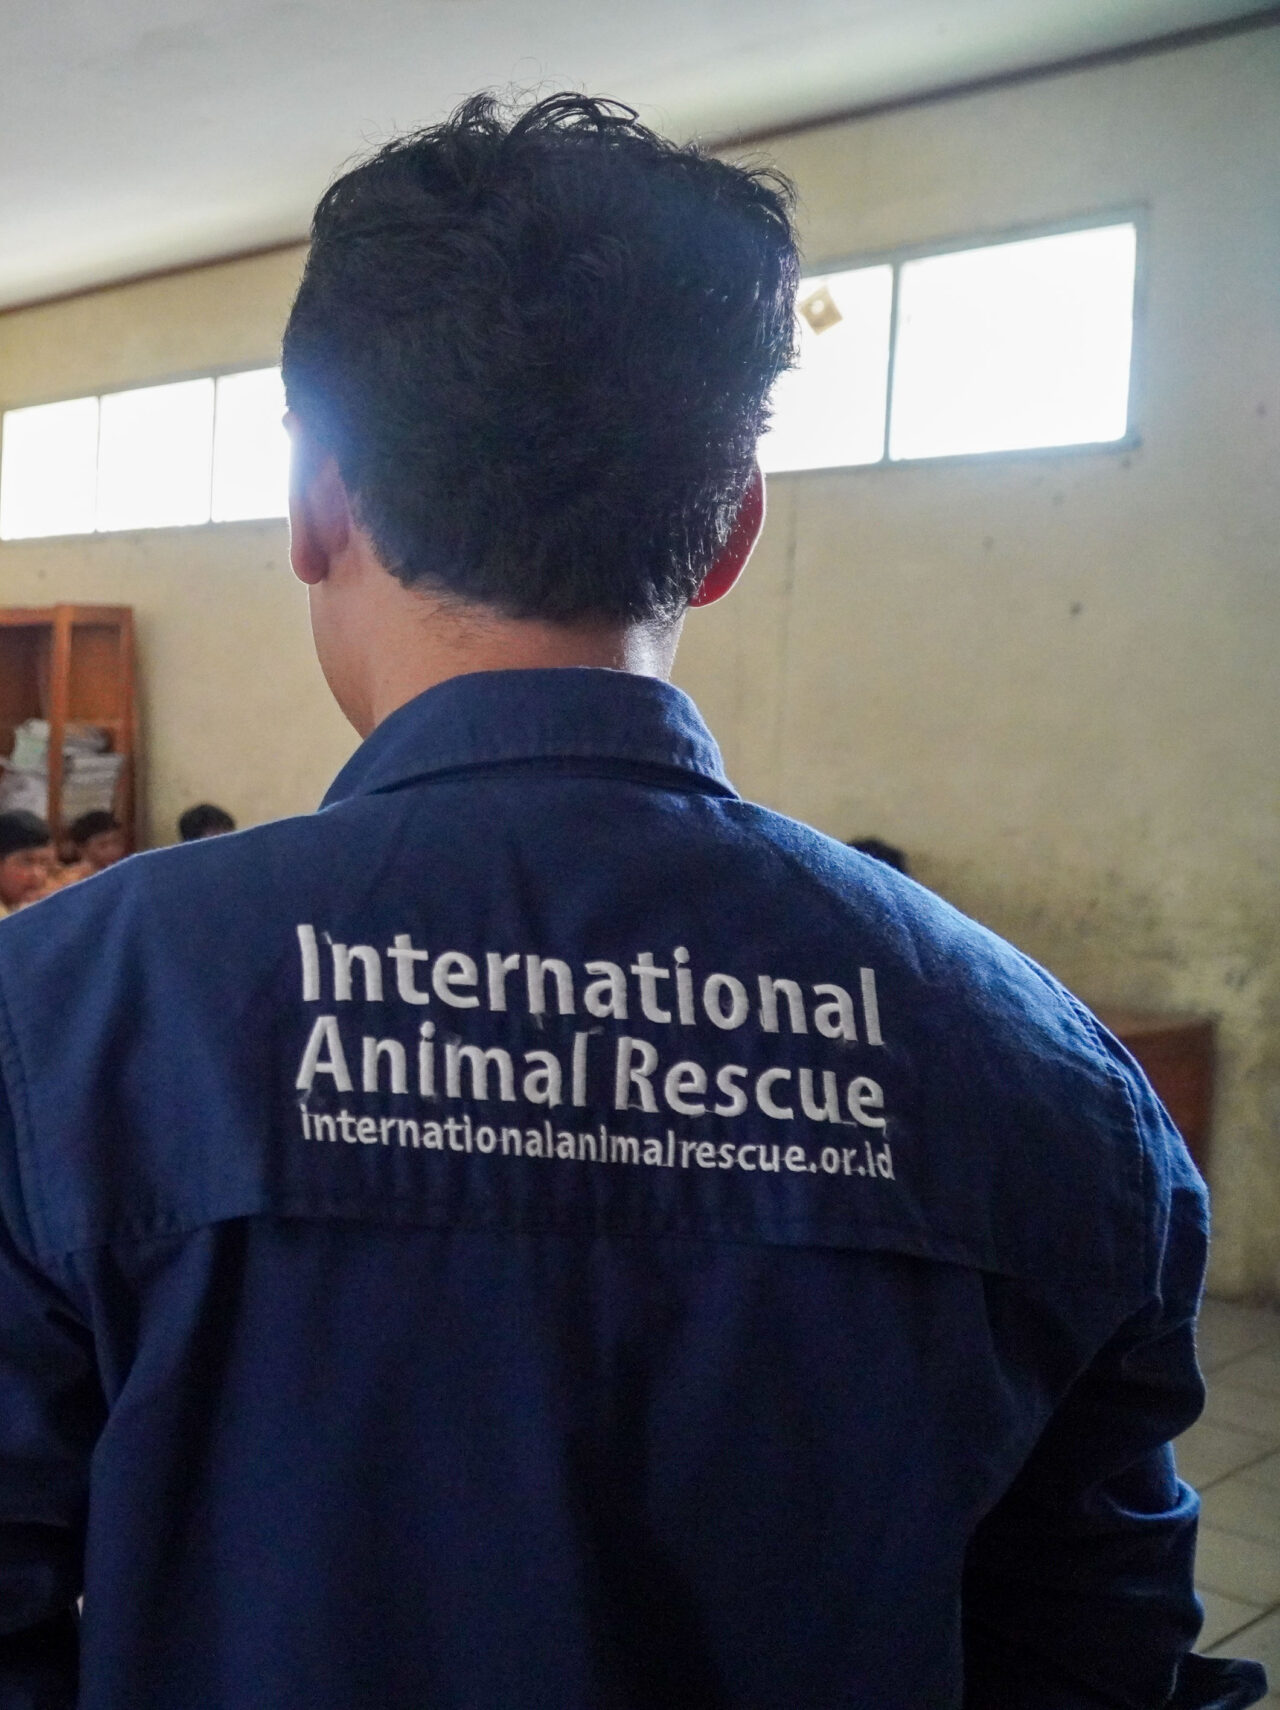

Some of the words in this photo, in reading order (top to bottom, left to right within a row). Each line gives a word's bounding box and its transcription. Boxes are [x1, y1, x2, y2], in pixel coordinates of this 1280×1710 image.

[296, 923, 885, 1046] International
[295, 1015, 588, 1108] Animal
[615, 1036, 888, 1128] Rescue
[300, 1103, 896, 1180] internationalanimalrescue.or.id
